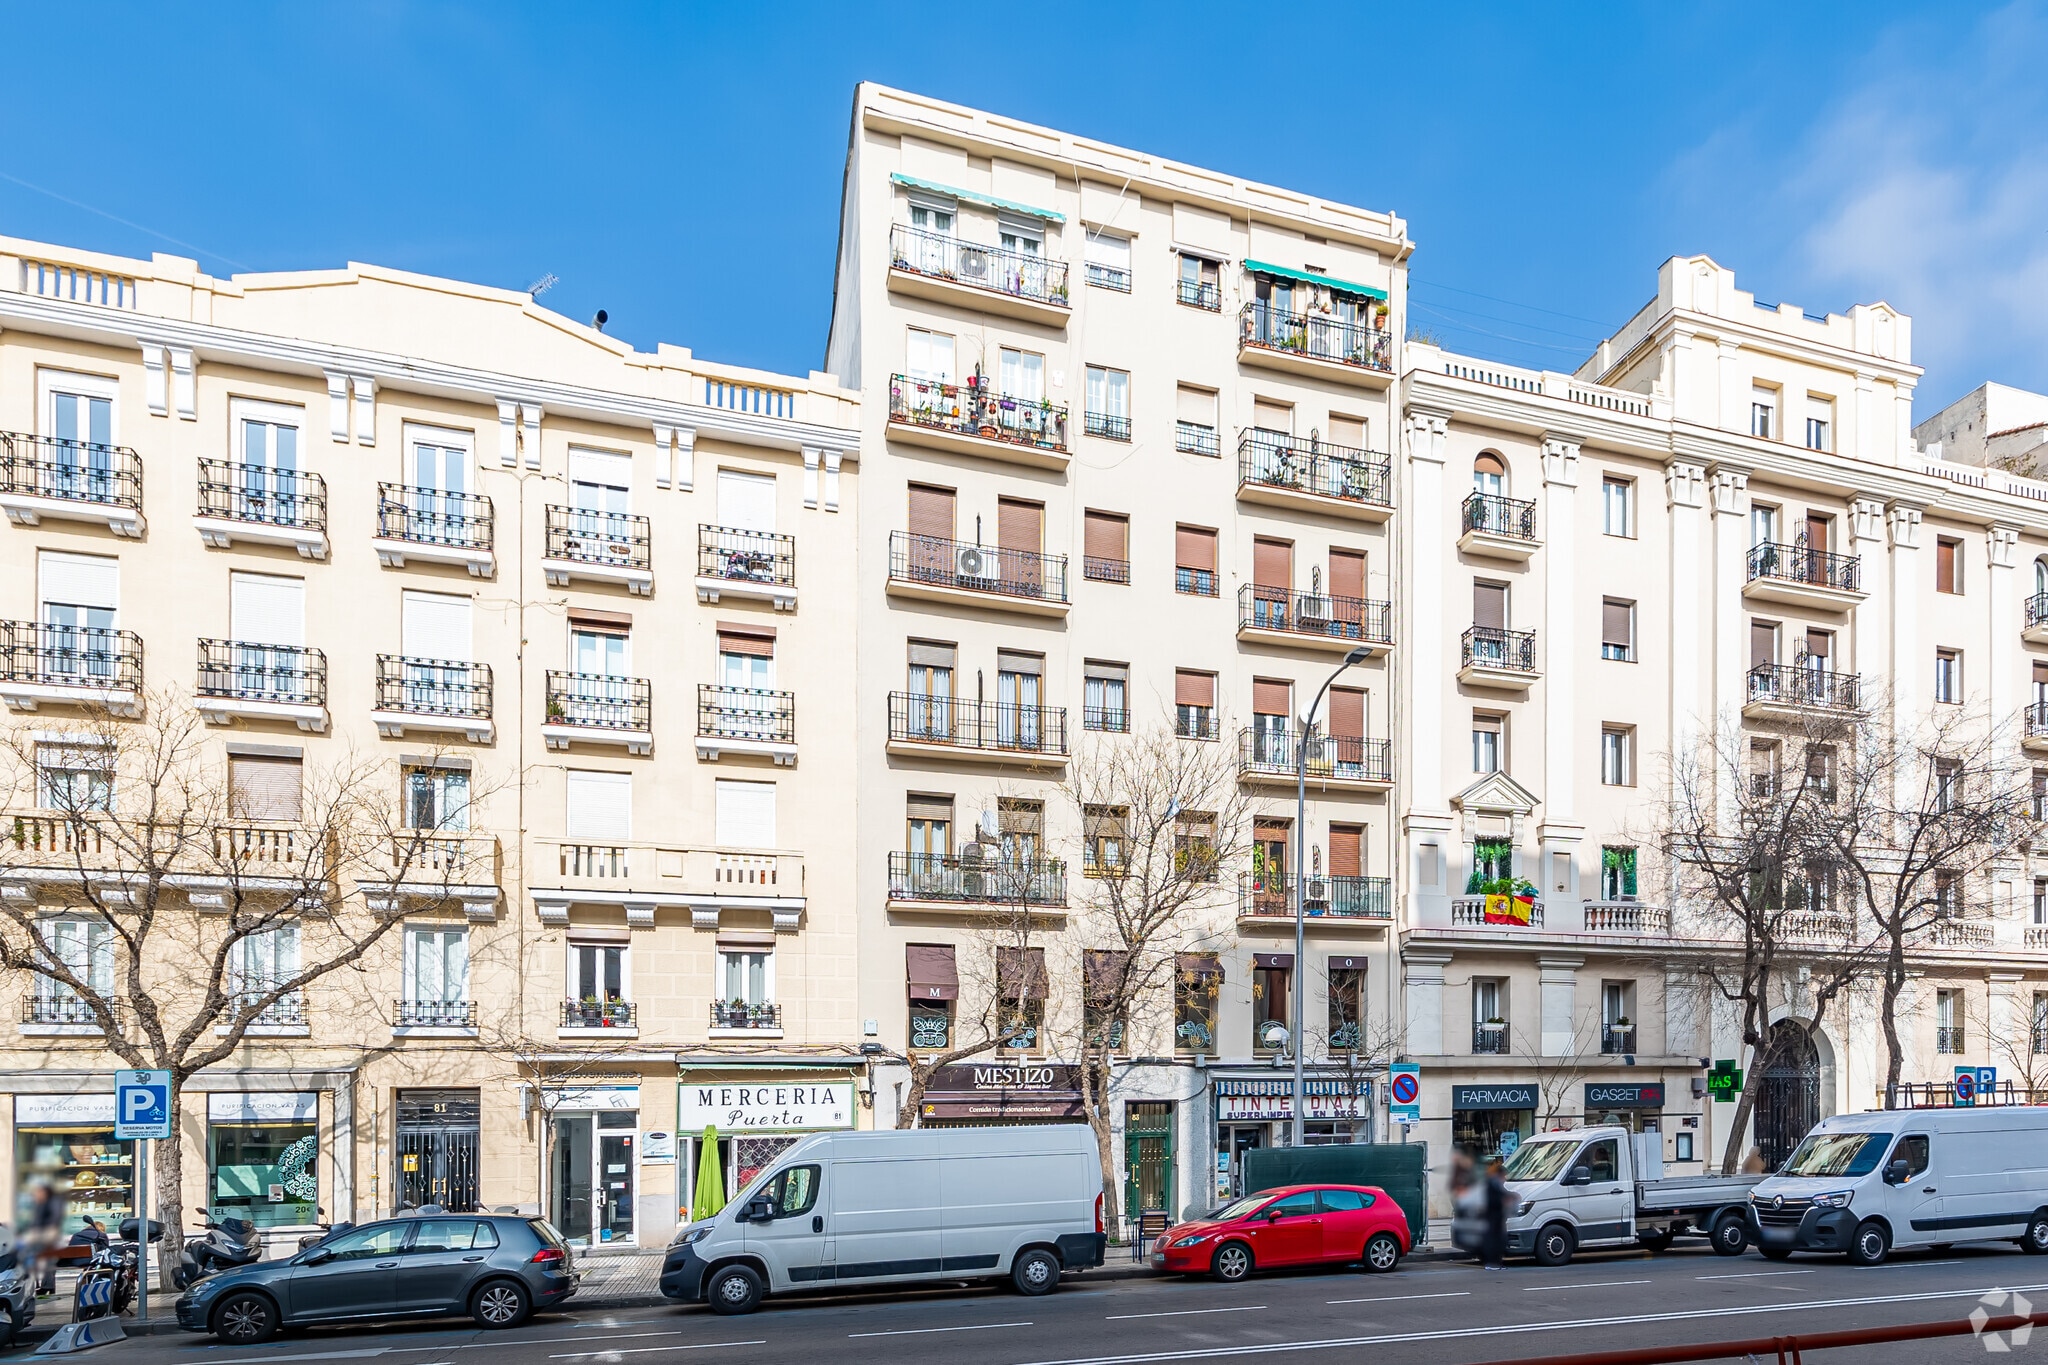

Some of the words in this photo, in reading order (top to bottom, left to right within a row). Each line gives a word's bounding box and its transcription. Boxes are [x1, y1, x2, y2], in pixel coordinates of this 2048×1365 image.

[1271, 957, 1277, 965] C
[1346, 958, 1352, 966] O
[929, 988, 940, 996] M
[973, 1068, 1054, 1084] MESTIZO
[1980, 1069, 1993, 1091] P
[698, 1087, 836, 1106] MERCERIA
[1461, 1089, 1531, 1103] FARMACIA
[1590, 1088, 1642, 1101] GASSET
[125, 1088, 156, 1121] P
[433, 1103, 447, 1113] 81
[1228, 1096, 1290, 1111] TINTE
[1310, 1095, 1358, 1110] DIAZ
[726, 1109, 804, 1126] Puerta
[834, 1112, 843, 1120] 81
[1312, 1110, 1327, 1118] EN
